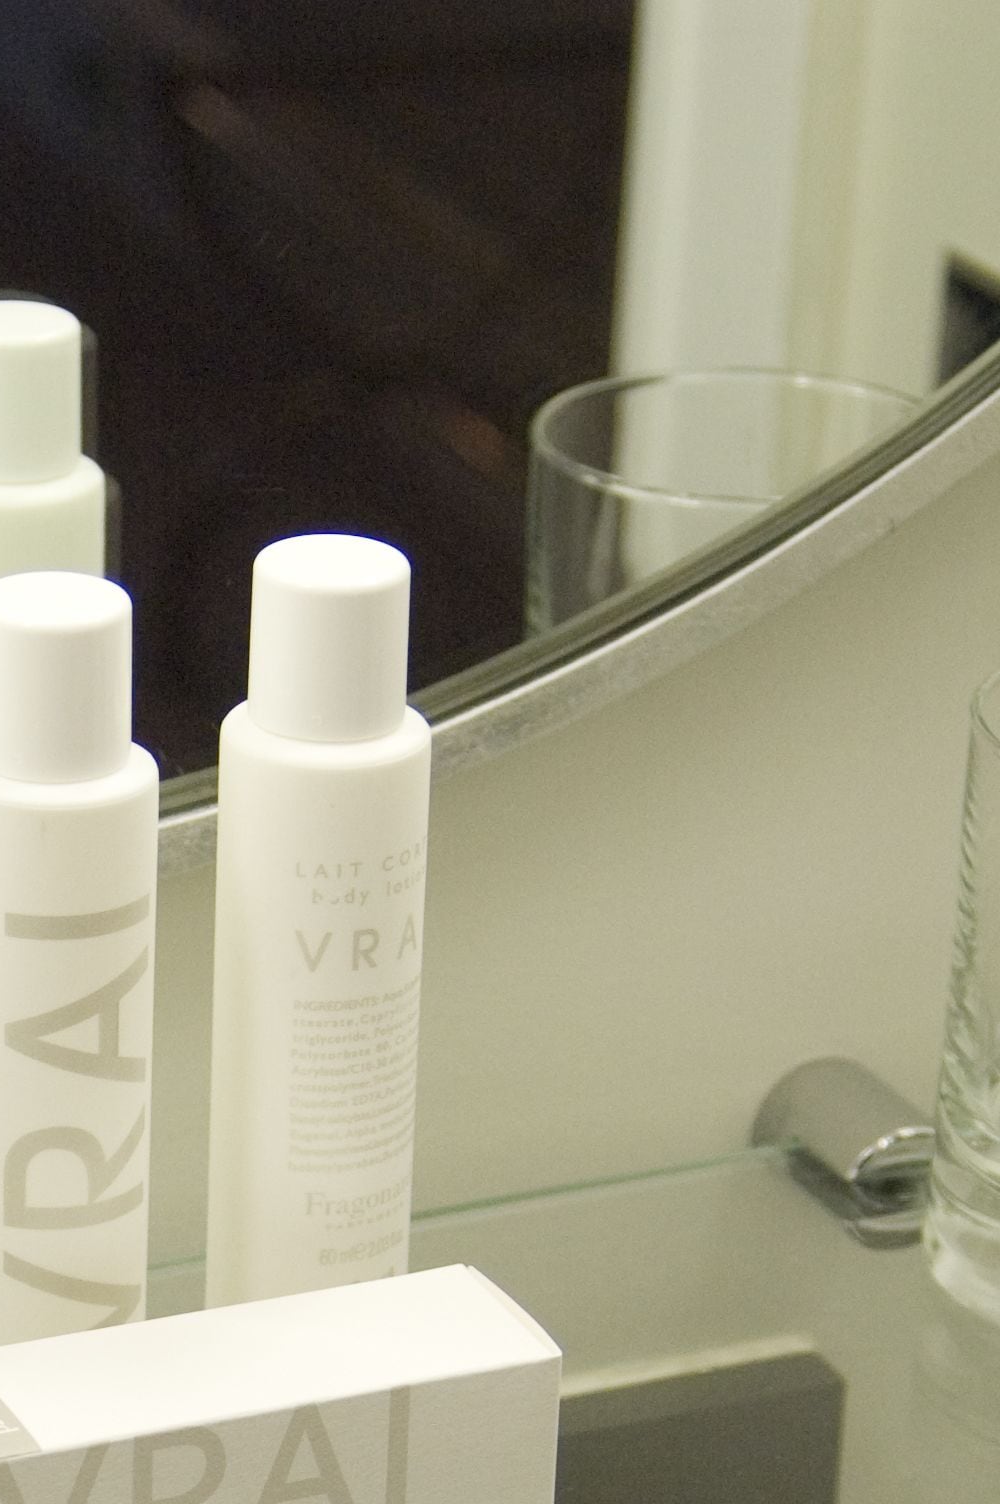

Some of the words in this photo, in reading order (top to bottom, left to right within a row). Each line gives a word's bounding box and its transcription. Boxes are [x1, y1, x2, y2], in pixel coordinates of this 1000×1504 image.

[296, 861, 363, 879] LAIT
[295, 913, 417, 972] VRA
[2, 893, 150, 1331] VRAI
